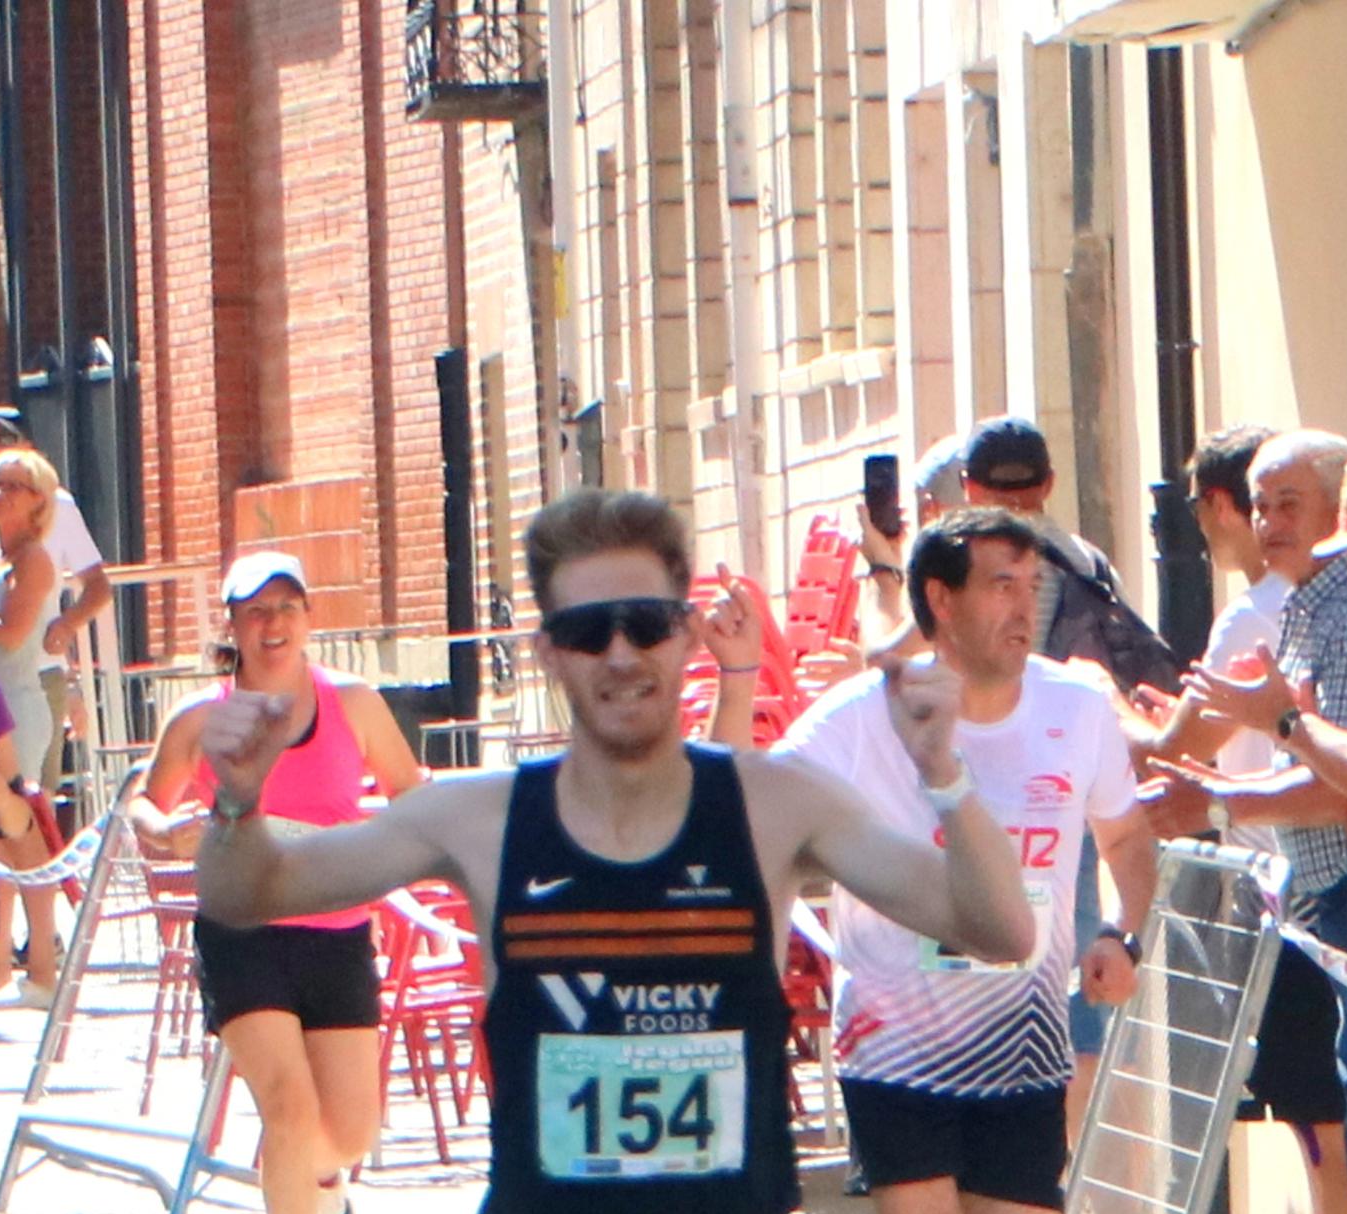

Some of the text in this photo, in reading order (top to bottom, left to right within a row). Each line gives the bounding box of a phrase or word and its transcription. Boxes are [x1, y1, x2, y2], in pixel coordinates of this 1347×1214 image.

[612, 984, 721, 1010] VICKY
[624, 1014, 710, 1032] FOODS
[568, 1073, 715, 1154] 154
